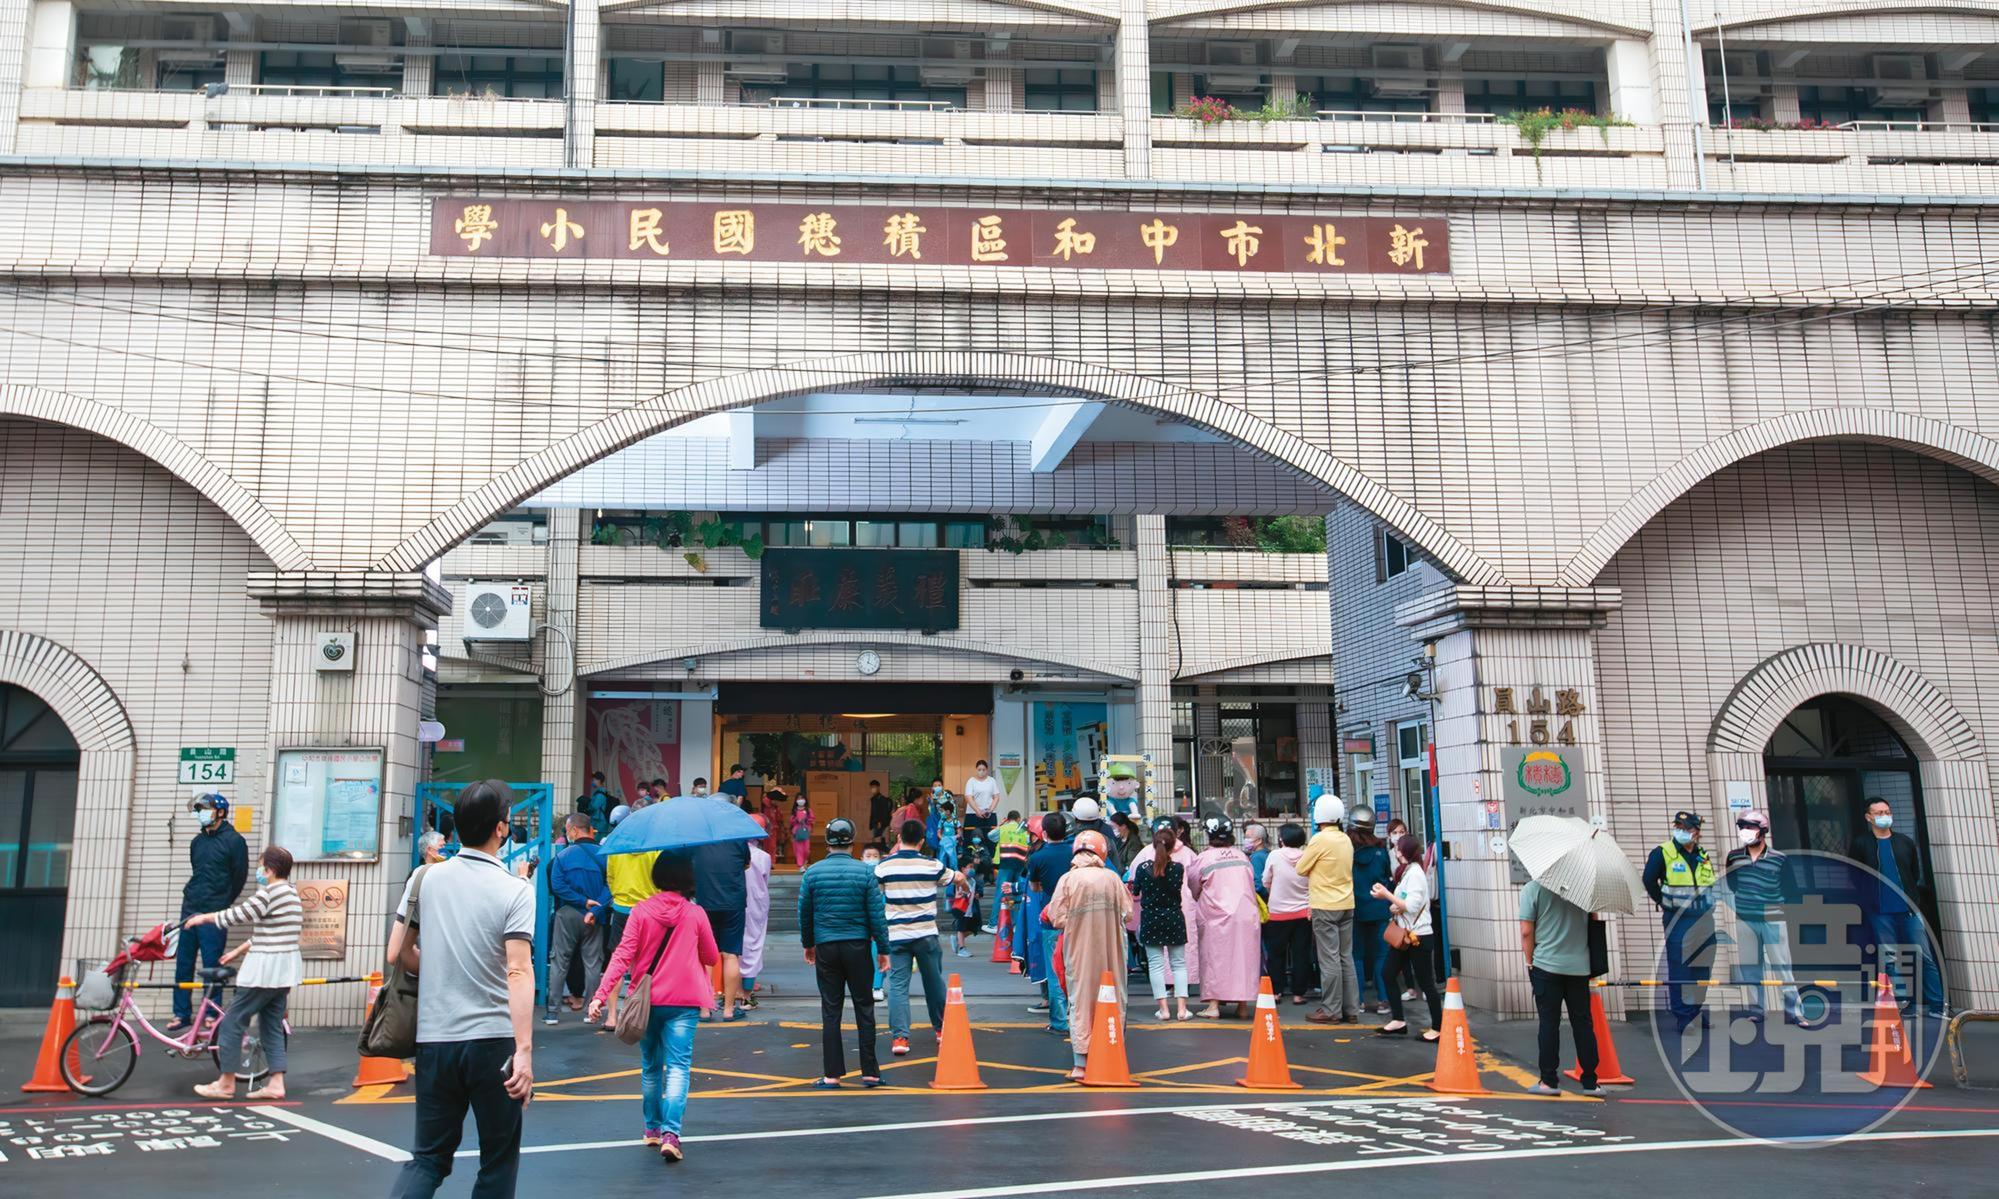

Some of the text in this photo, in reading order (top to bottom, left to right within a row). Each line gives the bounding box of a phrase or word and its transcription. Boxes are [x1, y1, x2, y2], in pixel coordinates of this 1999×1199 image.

[1493, 687, 1586, 717] 員山路
[1507, 720, 1575, 745] 154
[187, 763, 227, 780] 154
